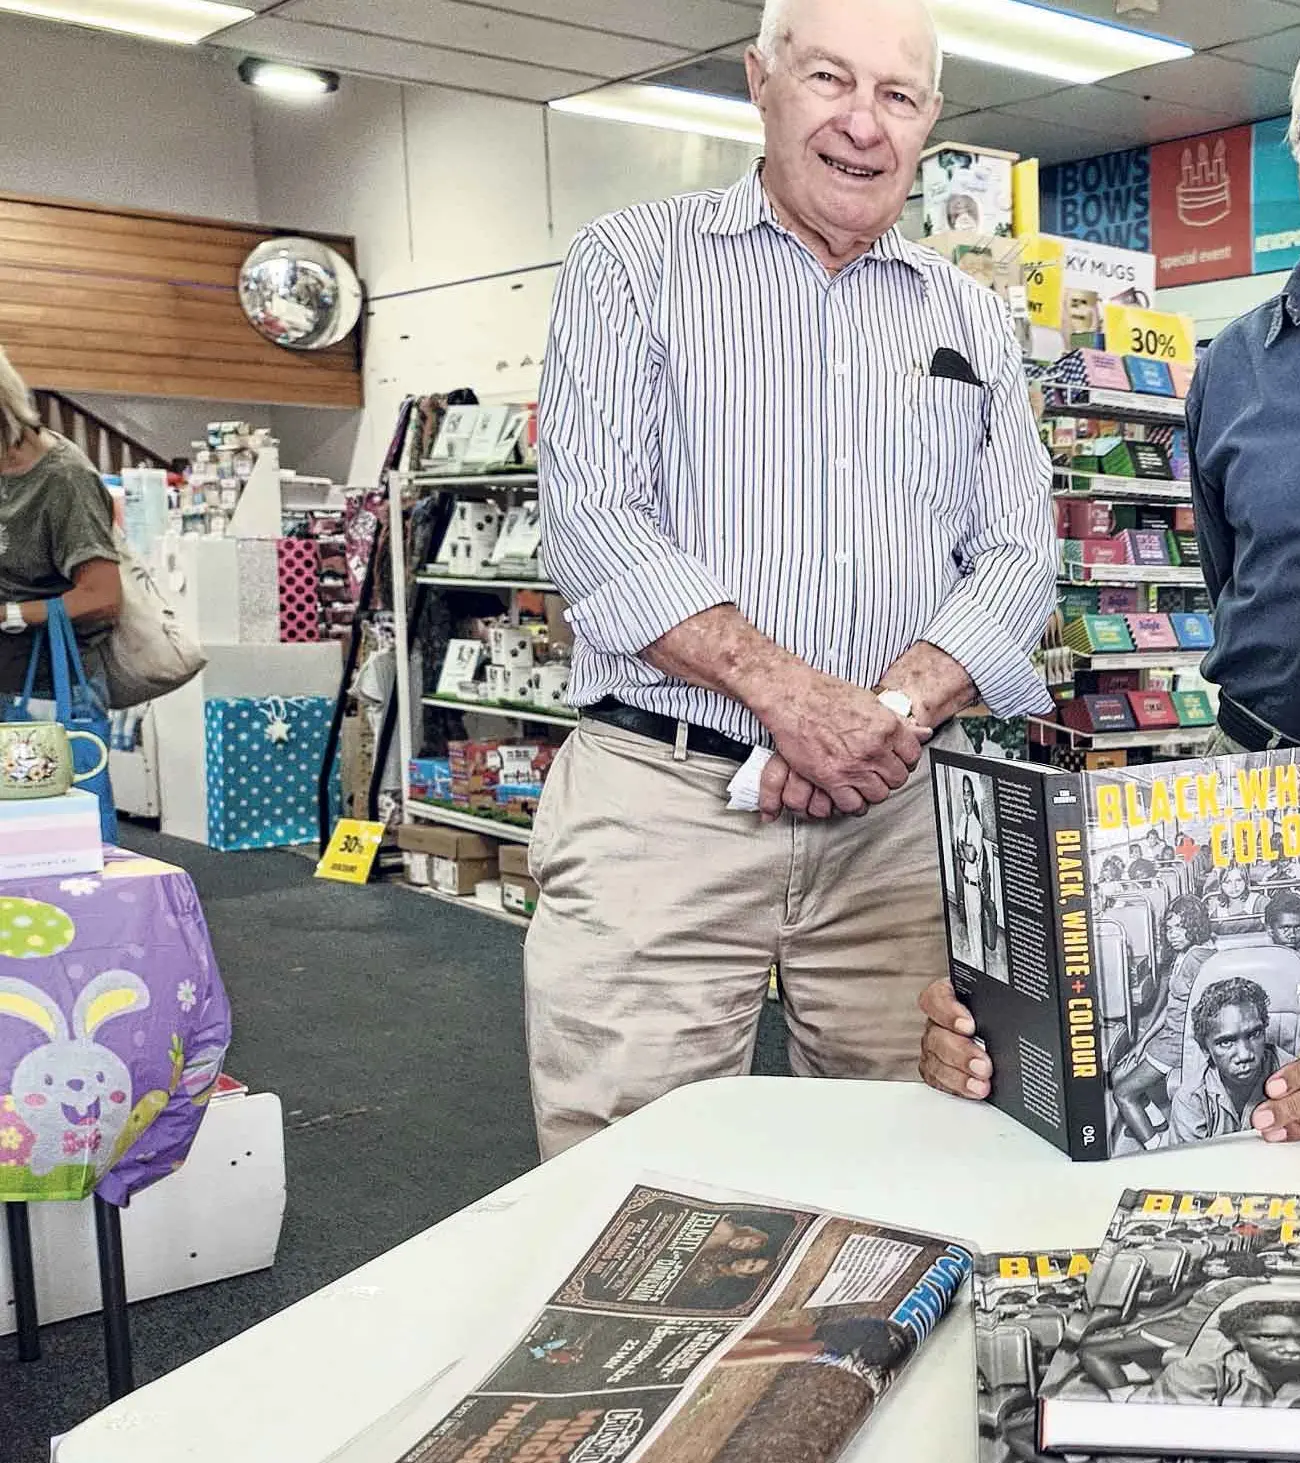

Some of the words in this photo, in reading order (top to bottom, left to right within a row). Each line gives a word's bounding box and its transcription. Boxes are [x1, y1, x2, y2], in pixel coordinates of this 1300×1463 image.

[1061, 152, 1149, 197] BOWS
[1061, 185, 1149, 230] BOWS
[1089, 258, 1136, 282] MUGS
[1130, 327, 1177, 358] 30%
[1055, 830, 1085, 906] BLACK,
[1062, 909, 1091, 977] WHITE
[1068, 997, 1097, 1079] COLOUR
[999, 1253, 1094, 1280] BLA
